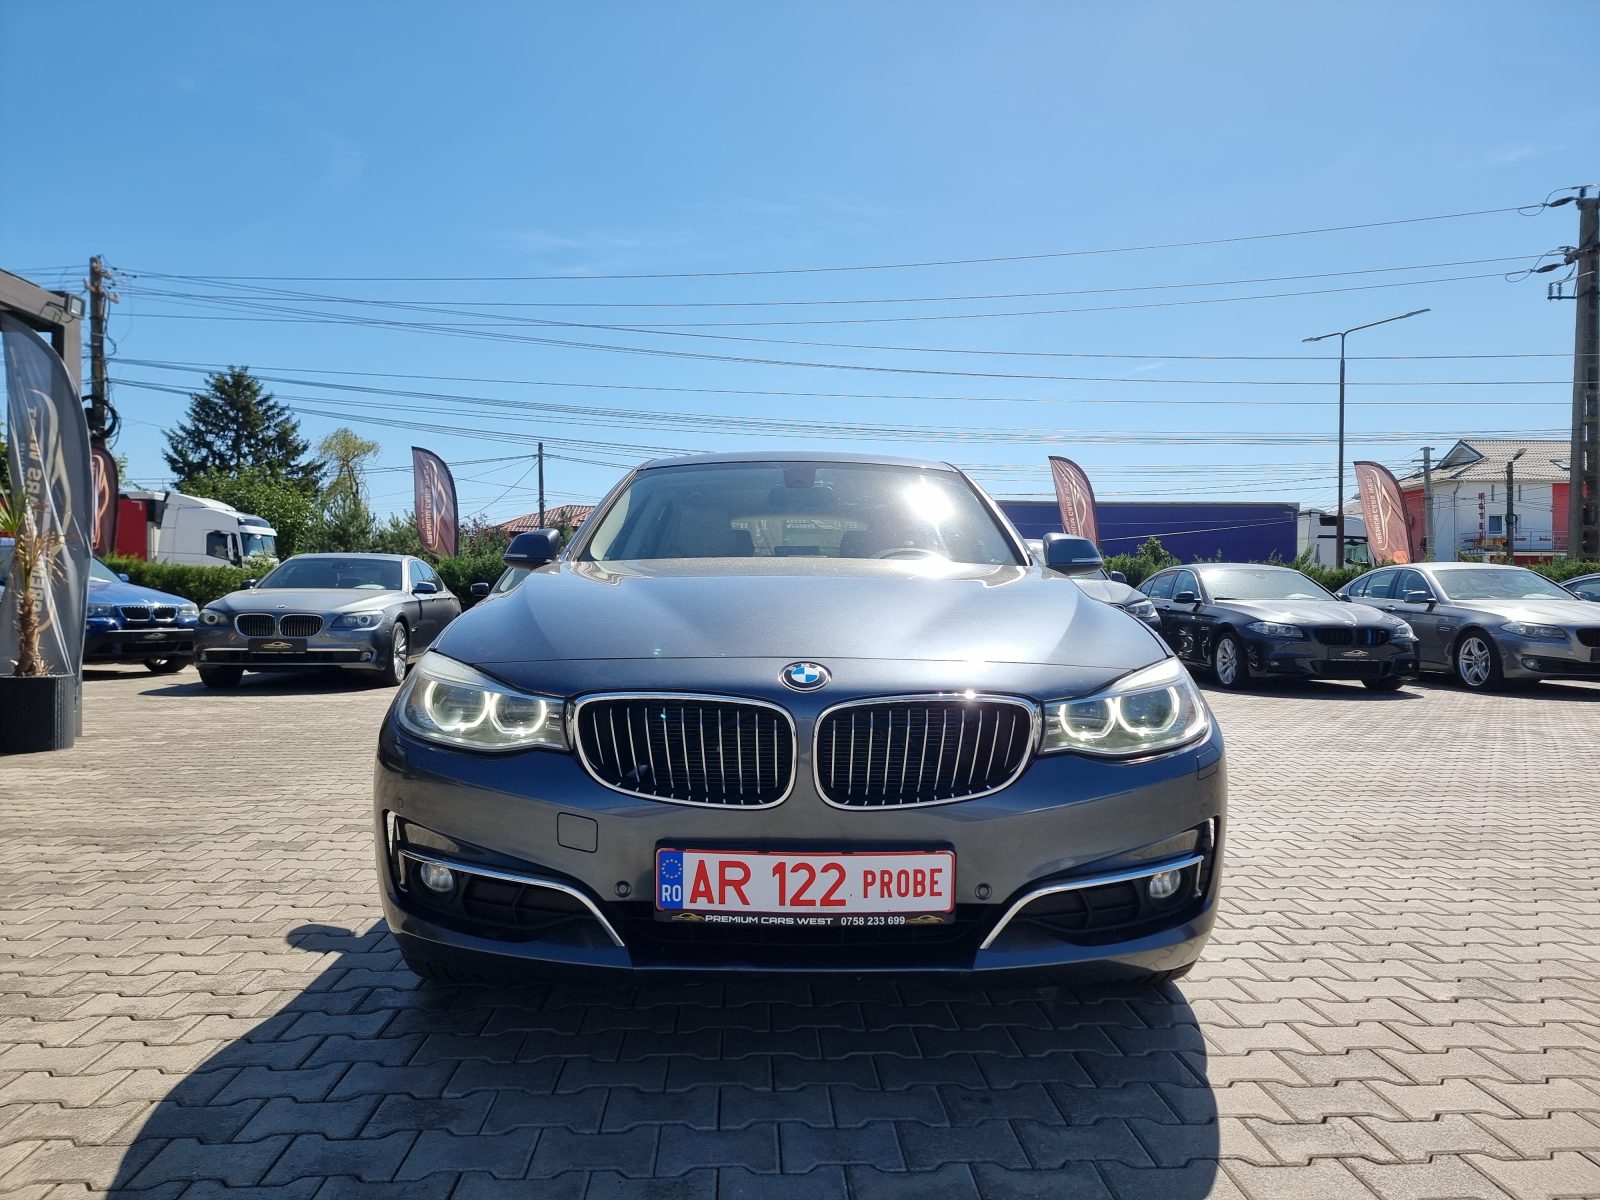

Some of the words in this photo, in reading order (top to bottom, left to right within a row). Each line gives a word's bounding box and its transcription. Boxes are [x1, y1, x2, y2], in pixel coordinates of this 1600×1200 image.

[689, 859, 752, 906] AR
[772, 862, 847, 907] 122
[863, 868, 943, 899] PROBE
[661, 884, 682, 902] RO
[705, 914, 758, 924] PREMIUM
[760, 917, 794, 925] CARS
[796, 917, 834, 925] WEST
[840, 916, 865, 926] 0758
[867, 916, 885, 926] 233
[887, 916, 906, 925] 699
